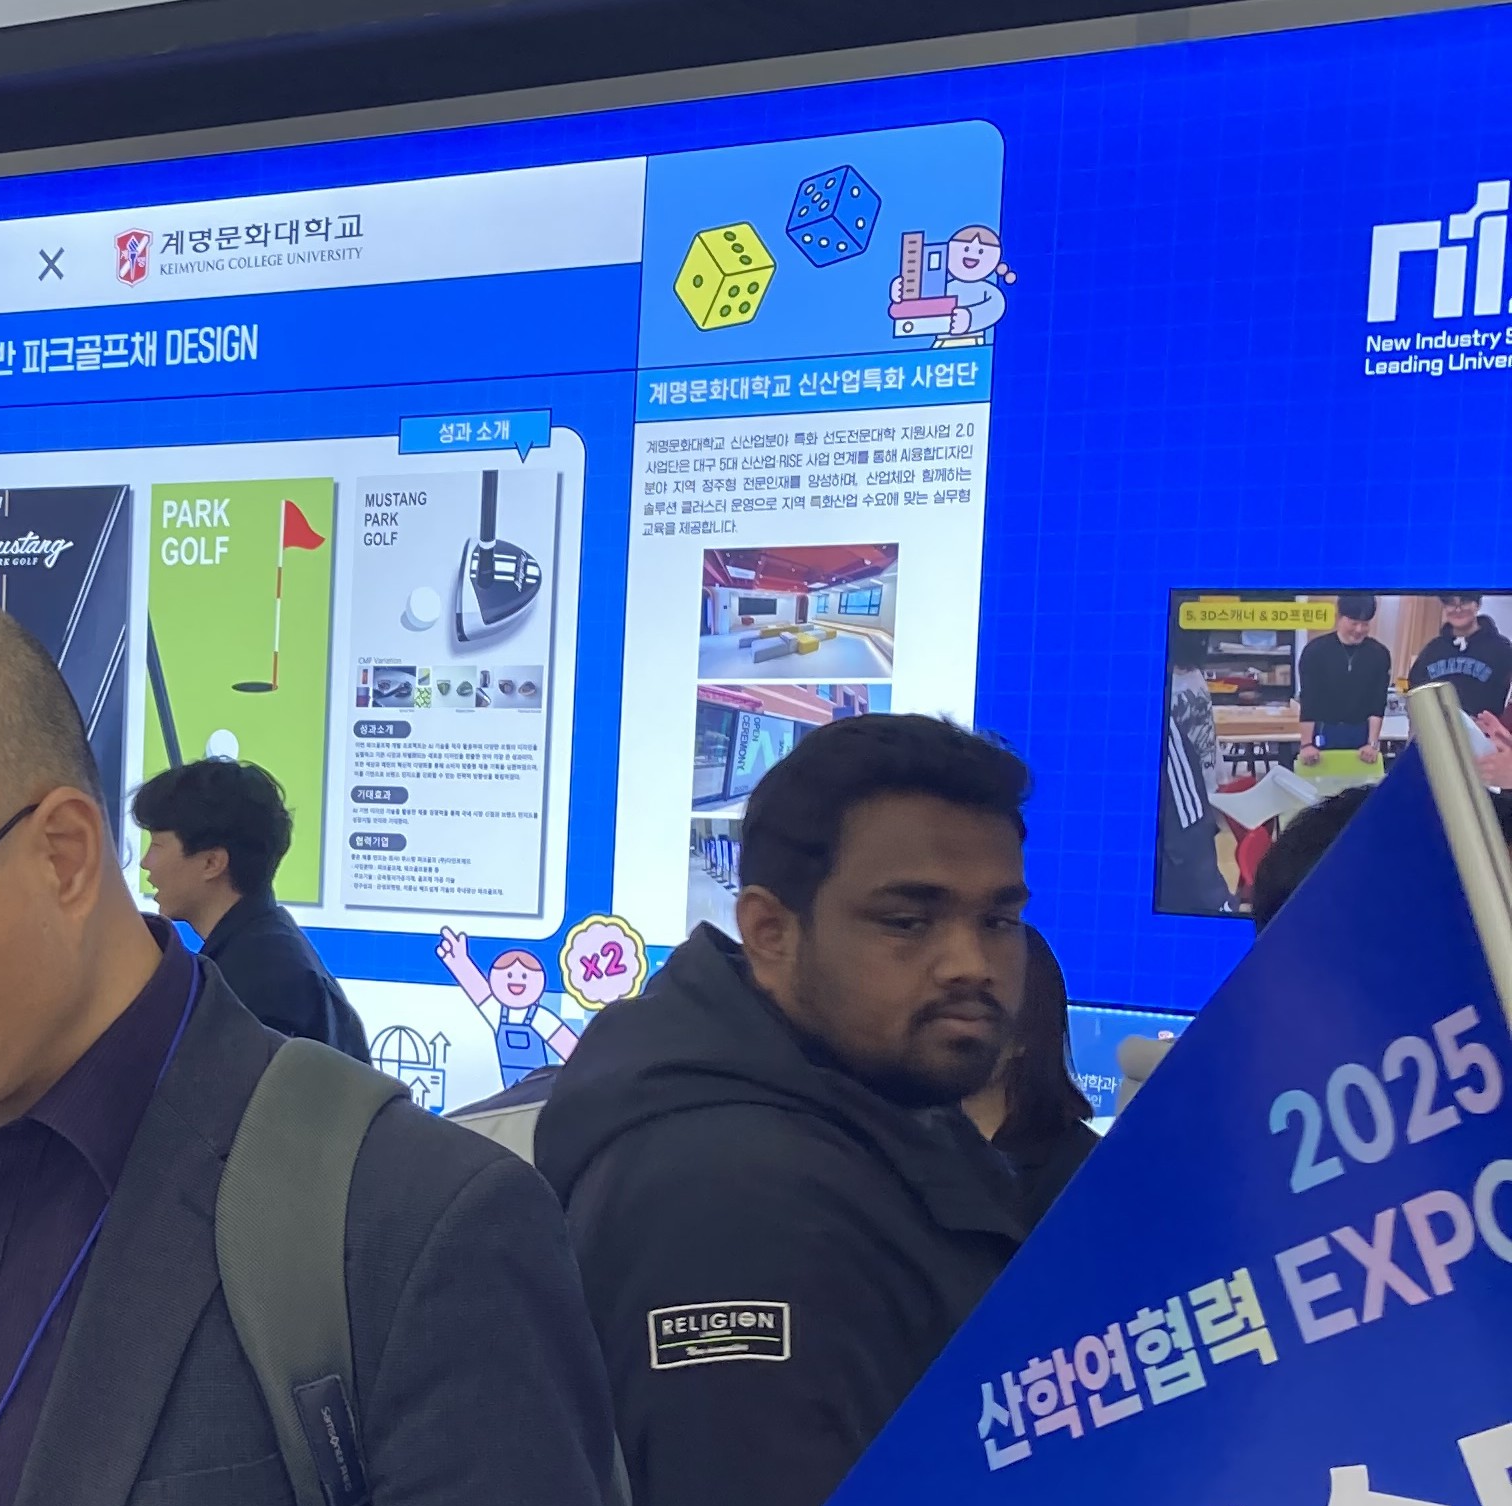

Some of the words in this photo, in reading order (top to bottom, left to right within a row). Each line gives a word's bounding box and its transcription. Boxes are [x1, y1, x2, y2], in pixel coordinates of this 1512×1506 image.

[160, 214, 364, 256] 계명문화대학교
[159, 258, 225, 276] KEIMYUNG
[228, 254, 283, 270] COLLEGE
[287, 247, 364, 265] UNIVERSITY
[22, 331, 158, 374] 파크골프채
[165, 324, 259, 366] DESIGN
[1366, 335, 1411, 353] New
[1415, 328, 1502, 350] Industry
[1365, 355, 1443, 376] Leading
[649, 373, 791, 405] 계명문화대학교
[798, 366, 905, 397] 신산업특화
[911, 361, 979, 388] 사업단
[439, 421, 470, 443] 성과
[475, 420, 510, 441] 소개
[646, 436, 725, 454] 계명문화대학교
[730, 433, 789, 450] 신산업분야
[794, 430, 817, 445] 특화
[823, 427, 896, 445] 선도전문대학
[900, 424, 950, 440] 지원사업
[956, 422, 975, 438] 2.0
[645, 459, 689, 474] 사업단은
[693, 458, 716, 472] 대구
[719, 456, 738, 471] 5대
[806, 451, 830, 467] 사업
[833, 450, 869, 465] 연계를
[644, 481, 667, 495] 분야
[673, 479, 696, 493] 지역
[702, 478, 736, 492] 정주형
[743, 475, 801, 491] 전문인재를
[865, 469, 915, 485] 산업체와
[922, 467, 972, 483] 함께하는
[364, 490, 427, 509] MUSTANG
[731, 497, 778, 512] 운영으로
[782, 495, 806, 510] 지역
[862, 491, 898, 507] 수요에
[903, 490, 928, 505] 맞는
[163, 497, 231, 530] PARK
[364, 511, 399, 529] PARK
[161, 534, 229, 567] GOLF
[363, 532, 399, 549] GOLF
[12, 557, 39, 566] GOLF
[1200, 609, 1255, 622] 3D스캐너
[1259, 610, 1268, 621] &
[1271, 609, 1327, 622] 3D프린터
[360, 724, 394, 735] 성과소개
[357, 789, 392, 800] 기대효과
[1269, 1004, 1502, 1194] 2025
[662, 1311, 775, 1336] RELIGION
[977, 1267, 1278, 1471] 산학연협력
